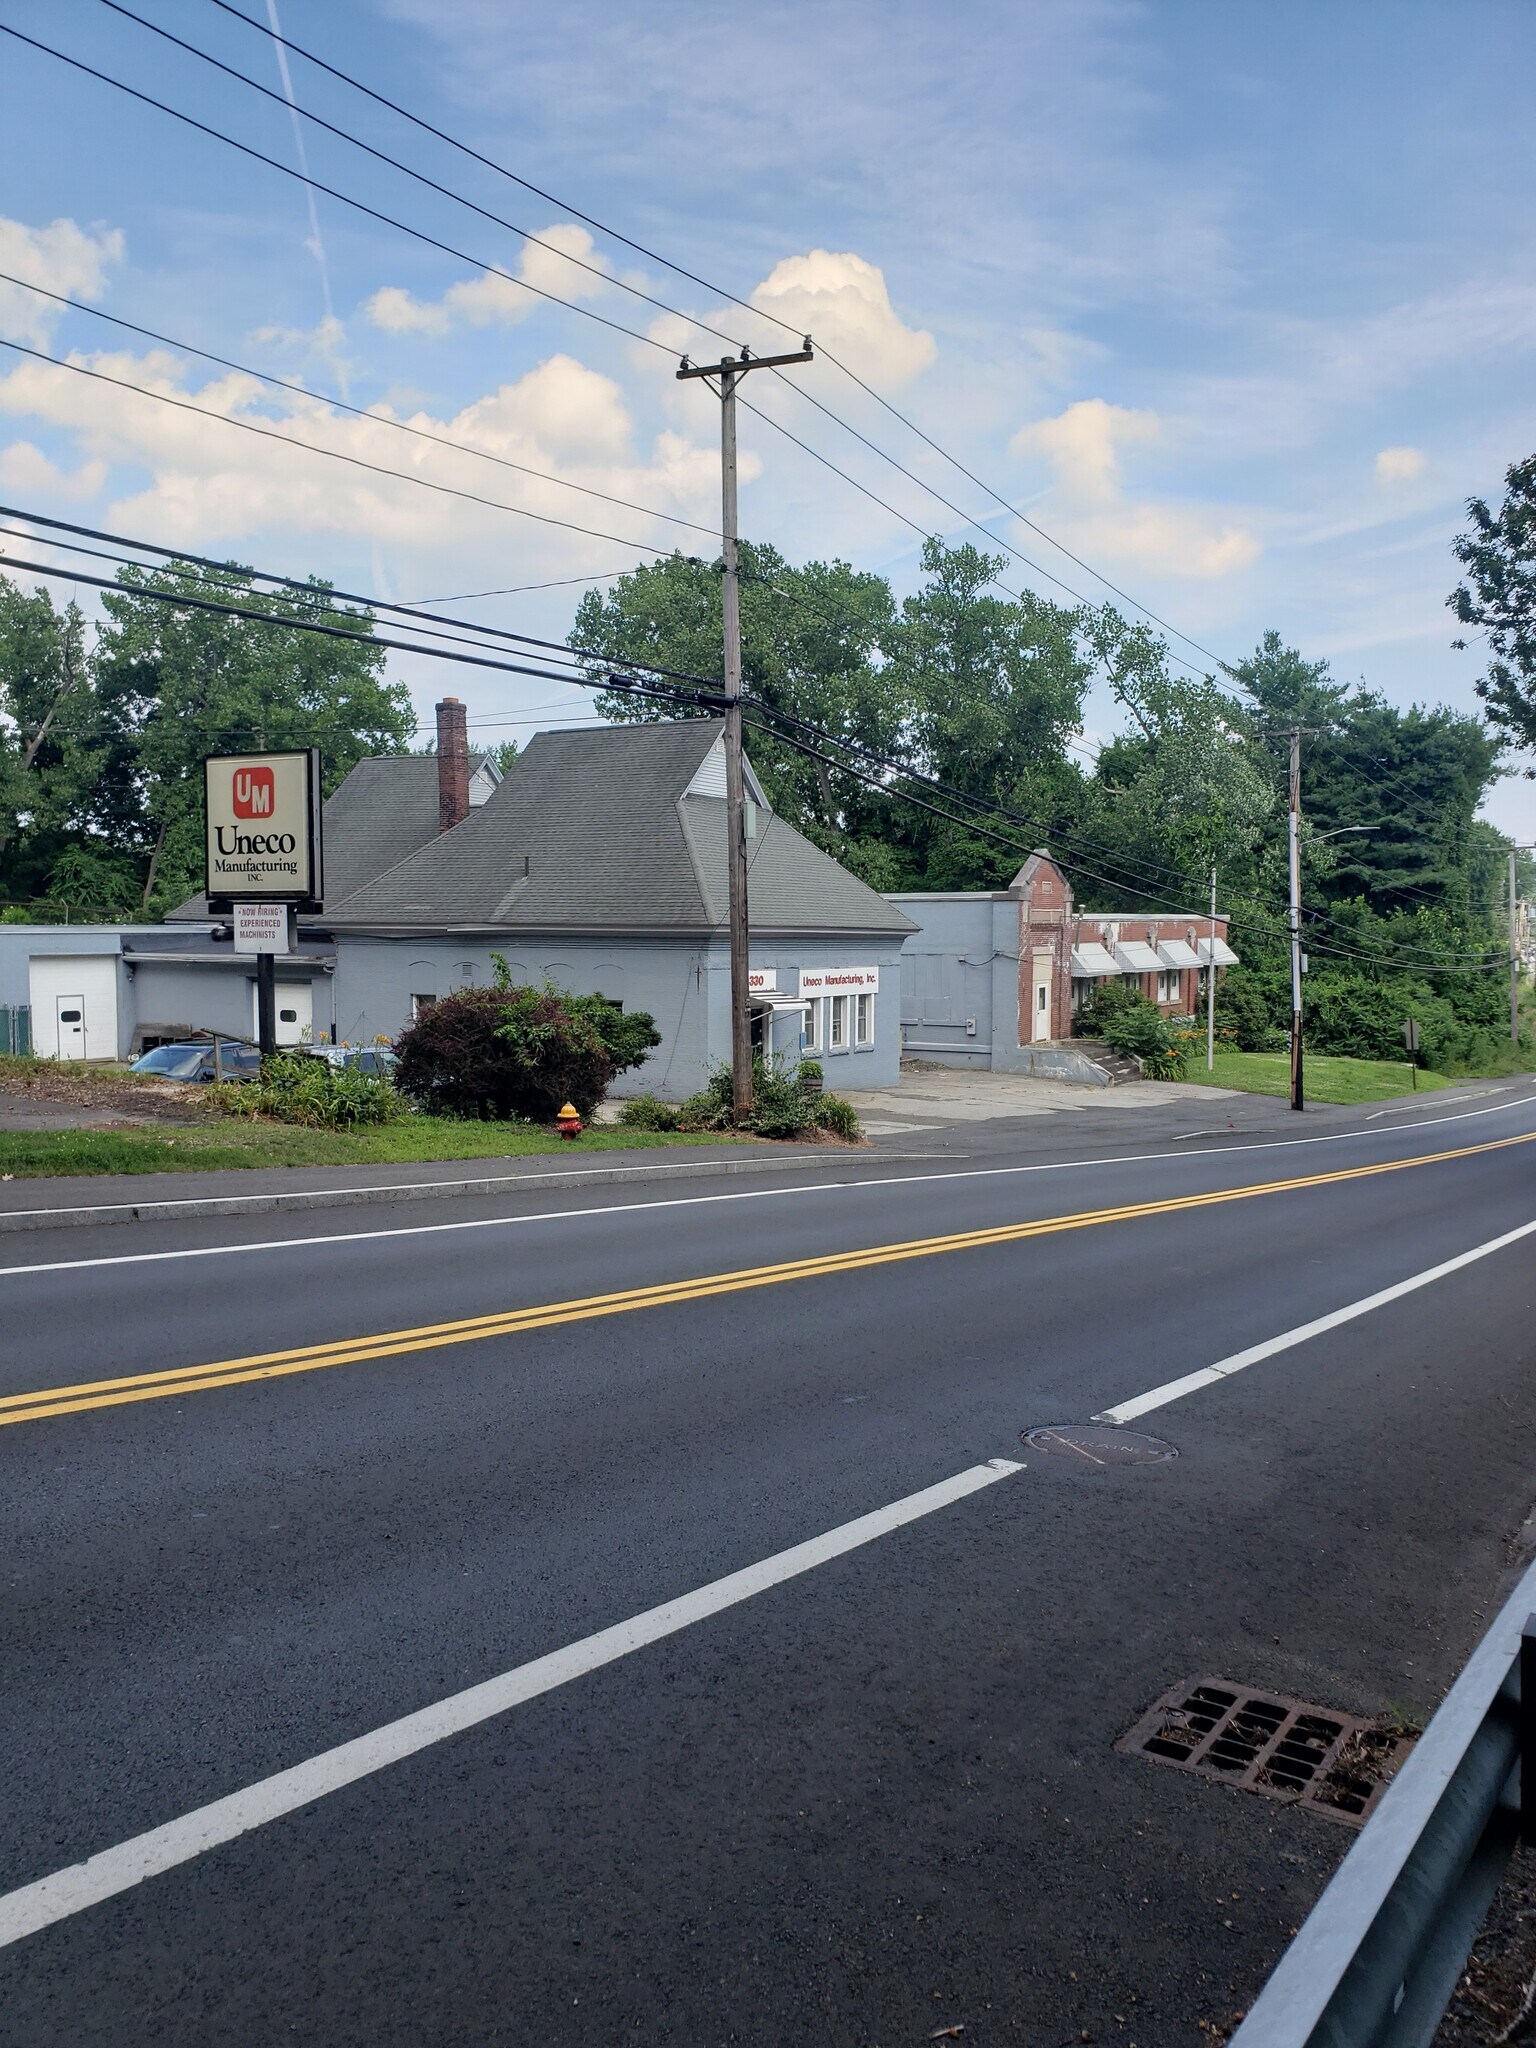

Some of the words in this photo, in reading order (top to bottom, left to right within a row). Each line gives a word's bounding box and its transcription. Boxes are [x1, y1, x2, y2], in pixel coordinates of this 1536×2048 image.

[215, 825, 296, 855] Uneco
[215, 858, 297, 875] Manufacturing
[247, 873, 264, 882] INC.
[240, 919, 281, 927] EXPERIENCED
[239, 930, 276, 939] MACHINISTS
[803, 976, 823, 987] Uneco
[866, 973, 876, 983] Inc.
[1063, 1438, 1134, 1452] DRAIN
